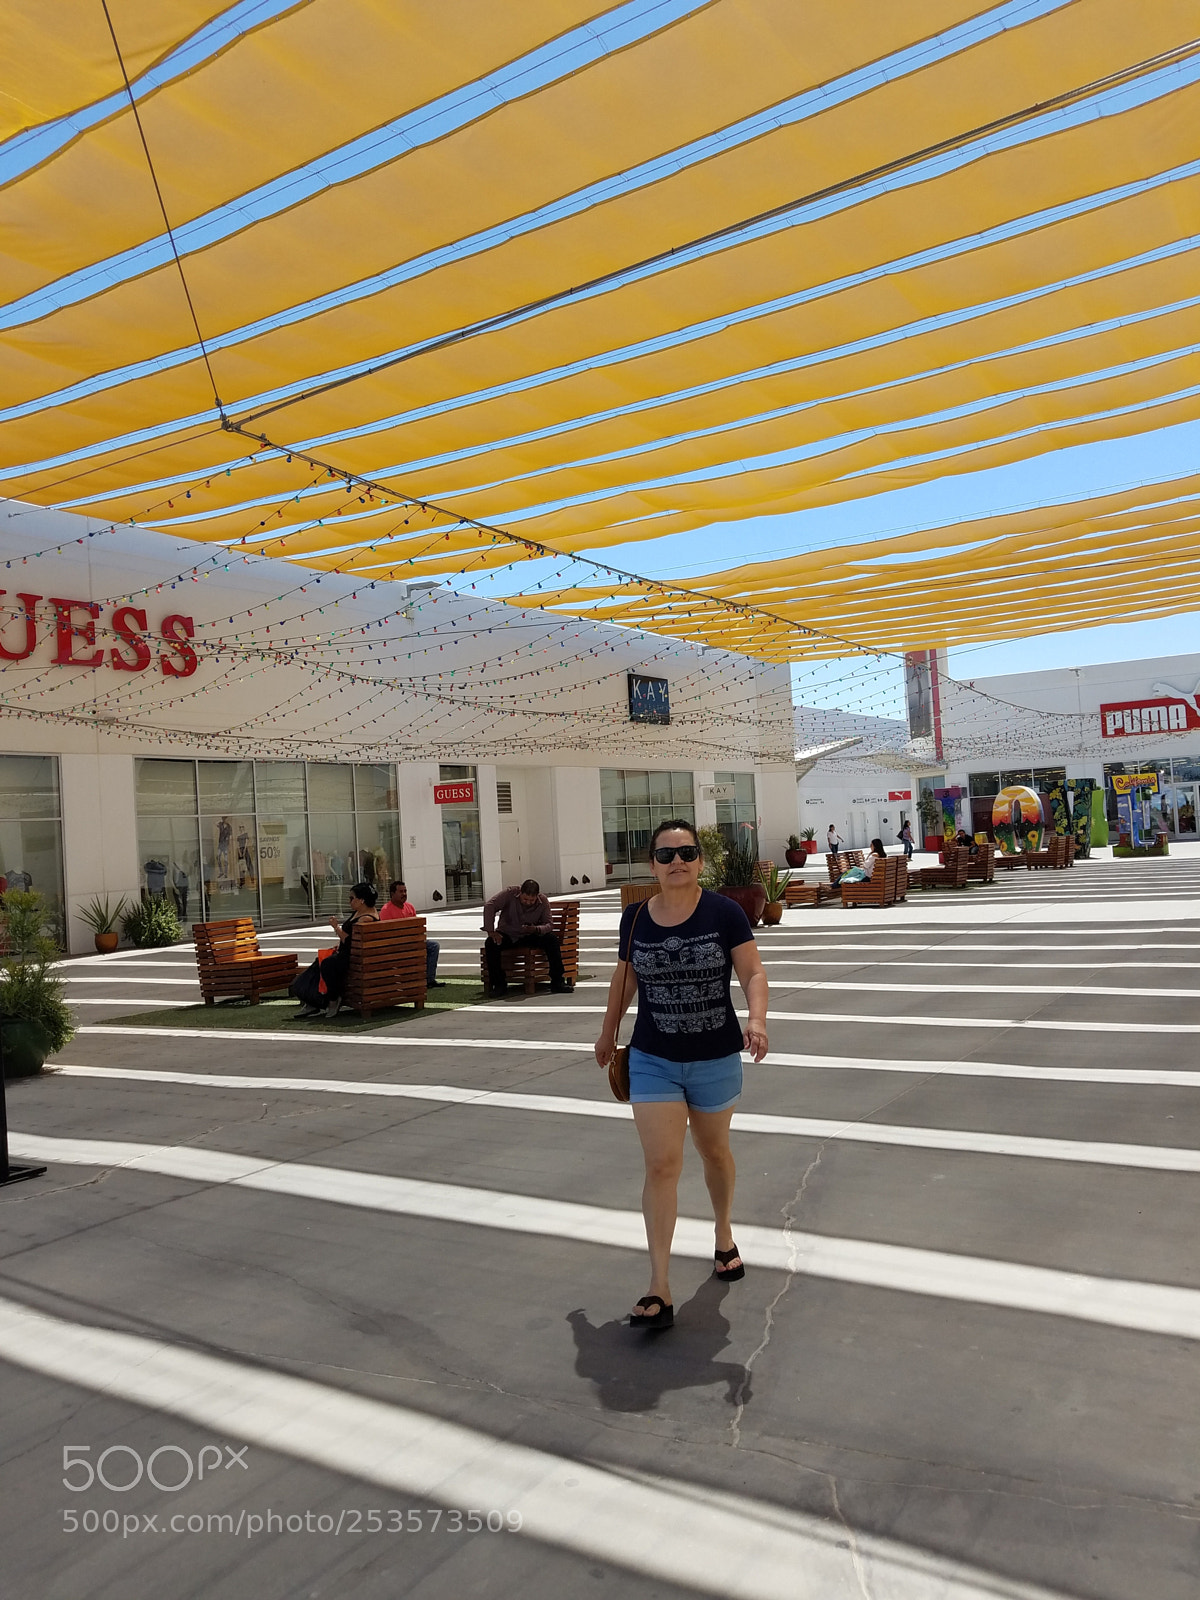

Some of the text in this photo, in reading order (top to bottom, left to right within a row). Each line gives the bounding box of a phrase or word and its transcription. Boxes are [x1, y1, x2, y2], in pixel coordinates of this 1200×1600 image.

[633, 679, 667, 702] KAY
[1106, 704, 1187, 735] PUMA
[436, 788, 471, 800] GUESS
[709, 787, 727, 795] KAY
